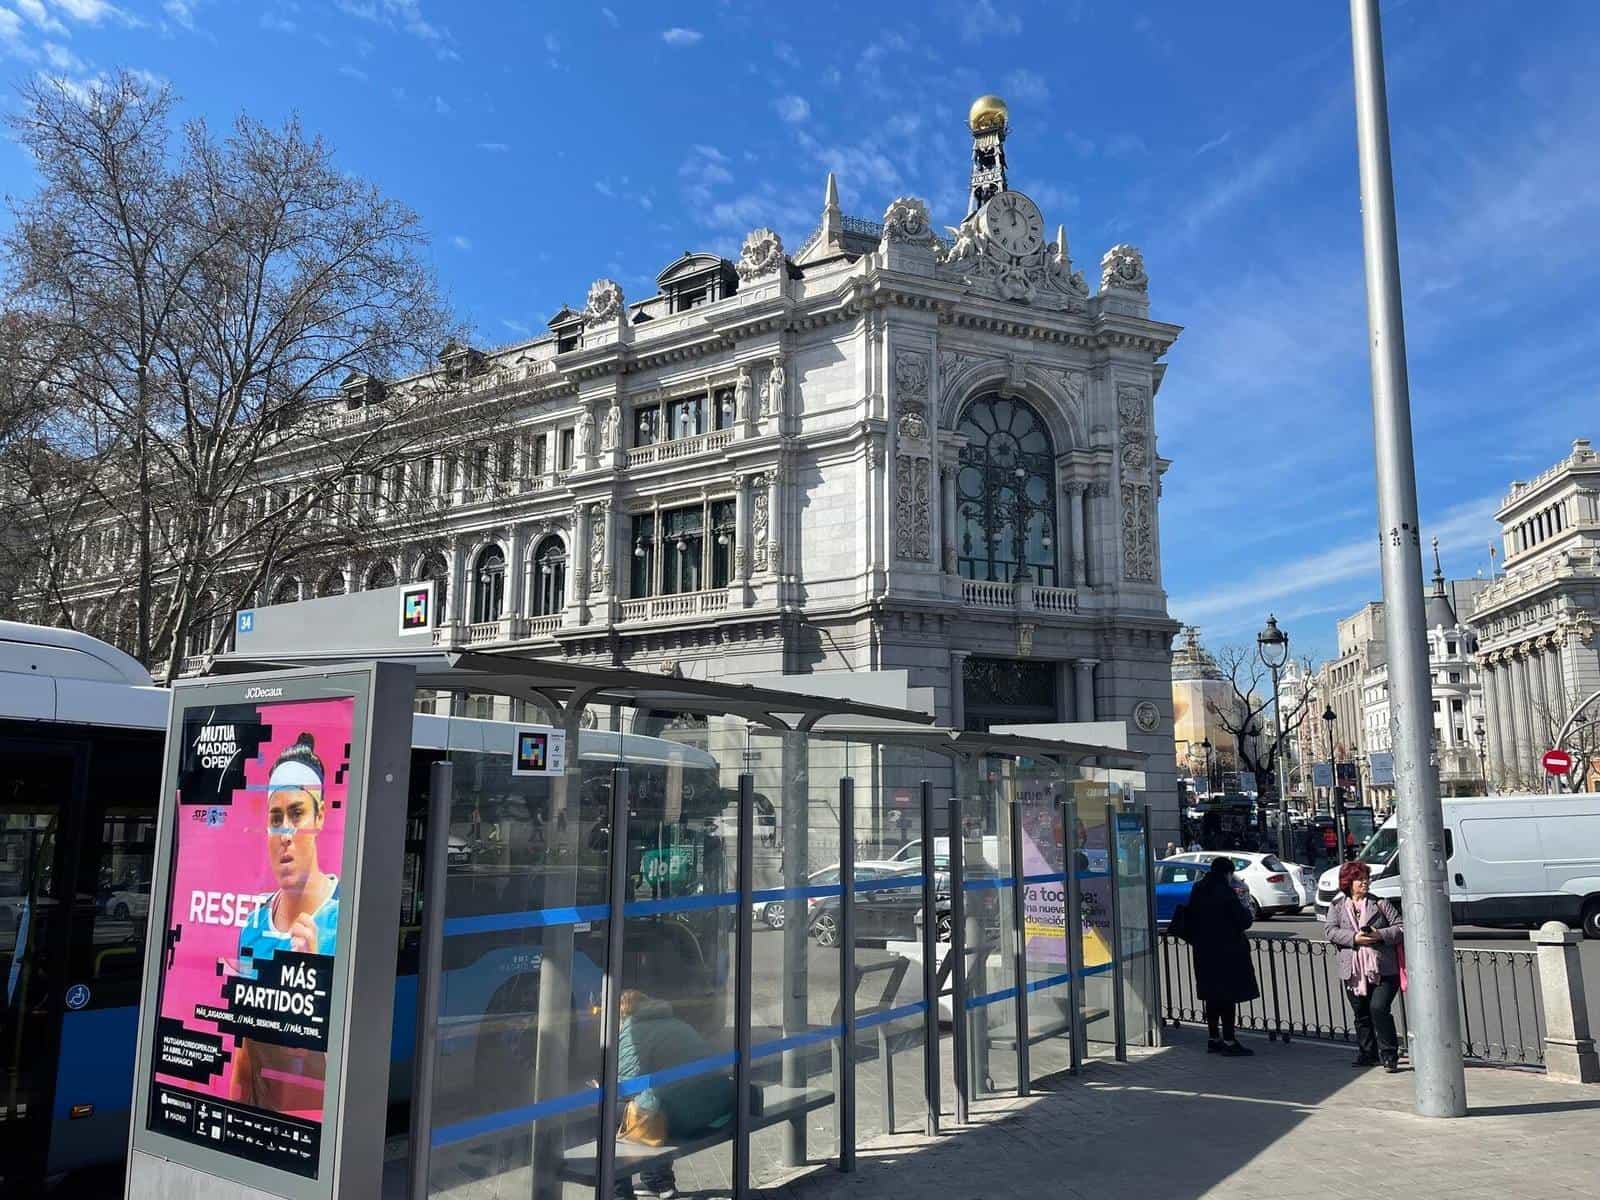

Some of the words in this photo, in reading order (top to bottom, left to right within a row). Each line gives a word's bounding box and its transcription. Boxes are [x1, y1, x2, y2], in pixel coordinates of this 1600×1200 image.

[239, 616, 251, 631] 34
[245, 687, 283, 698] JCDecaux
[200, 725, 235, 742] MUTUA
[197, 742, 237, 755] MADRID
[201, 757, 233, 768] OPEN
